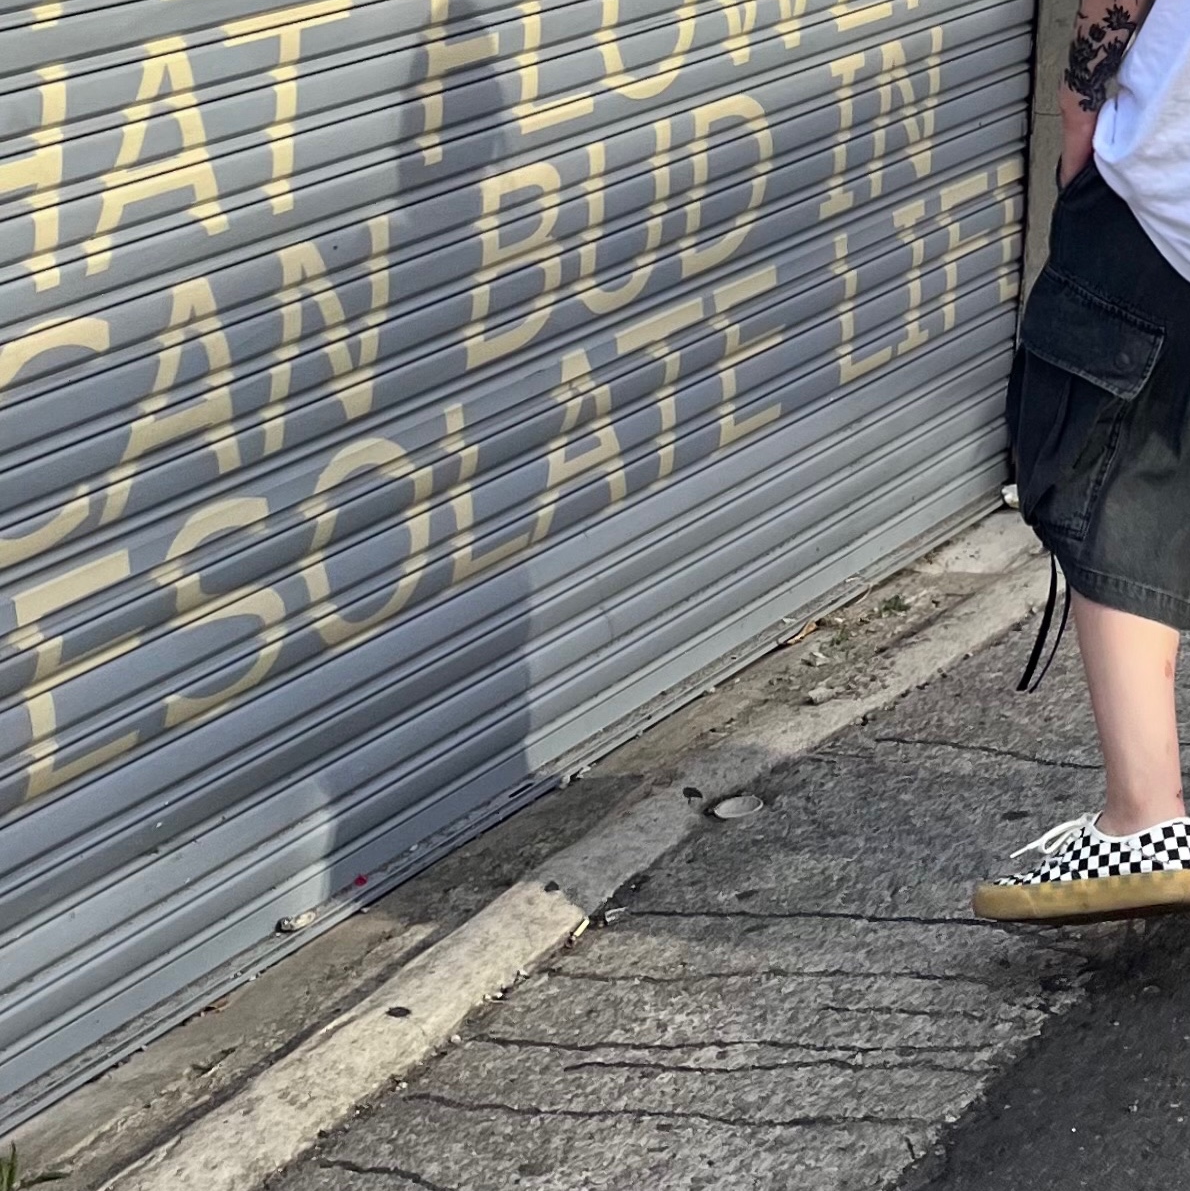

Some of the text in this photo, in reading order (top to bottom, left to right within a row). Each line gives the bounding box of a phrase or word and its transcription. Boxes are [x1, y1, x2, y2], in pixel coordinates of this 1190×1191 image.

[0, 26, 942, 566] CAN BUD IN
